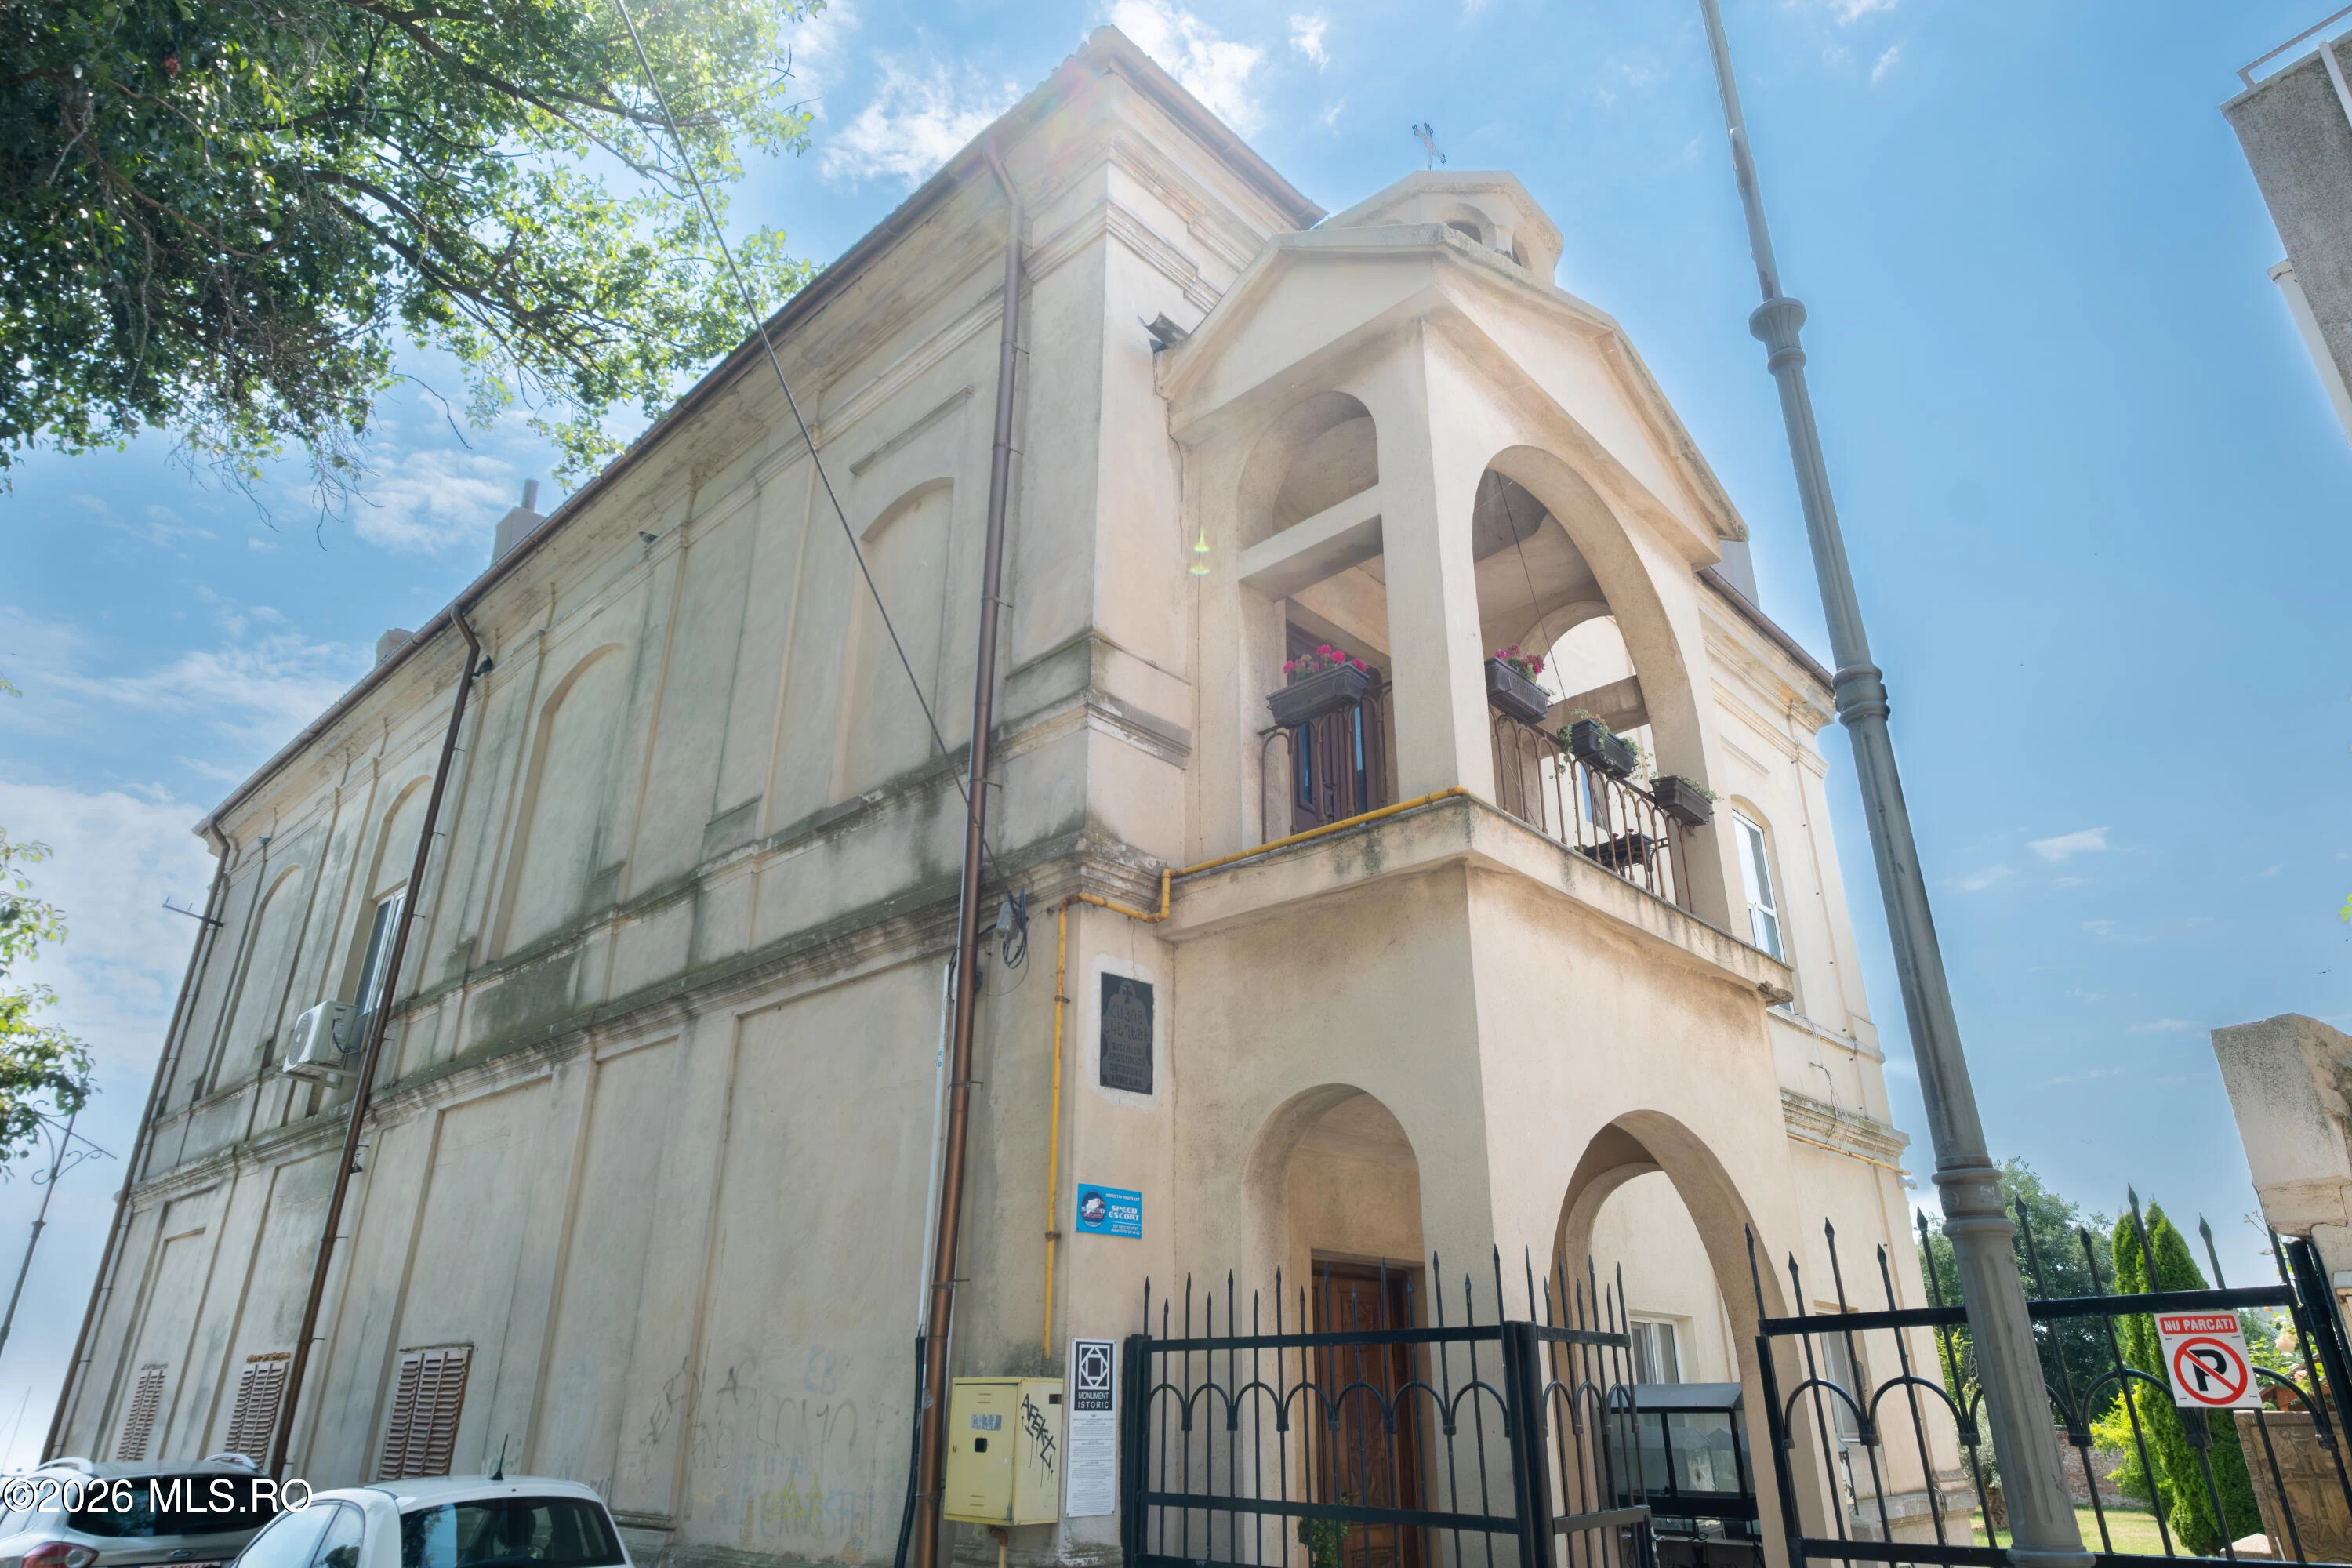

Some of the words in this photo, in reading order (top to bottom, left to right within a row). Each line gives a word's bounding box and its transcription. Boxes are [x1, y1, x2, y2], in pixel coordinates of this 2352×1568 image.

[1111, 1205, 1138, 1214] SPEED
[1108, 1211, 1139, 1221] ESCORT
[2164, 1319, 2180, 1331] NU
[2183, 1318, 2234, 1330] PARCATI
[1078, 1391, 1109, 1399] MONUMENT
[1077, 1400, 1109, 1410] ISTORIC
